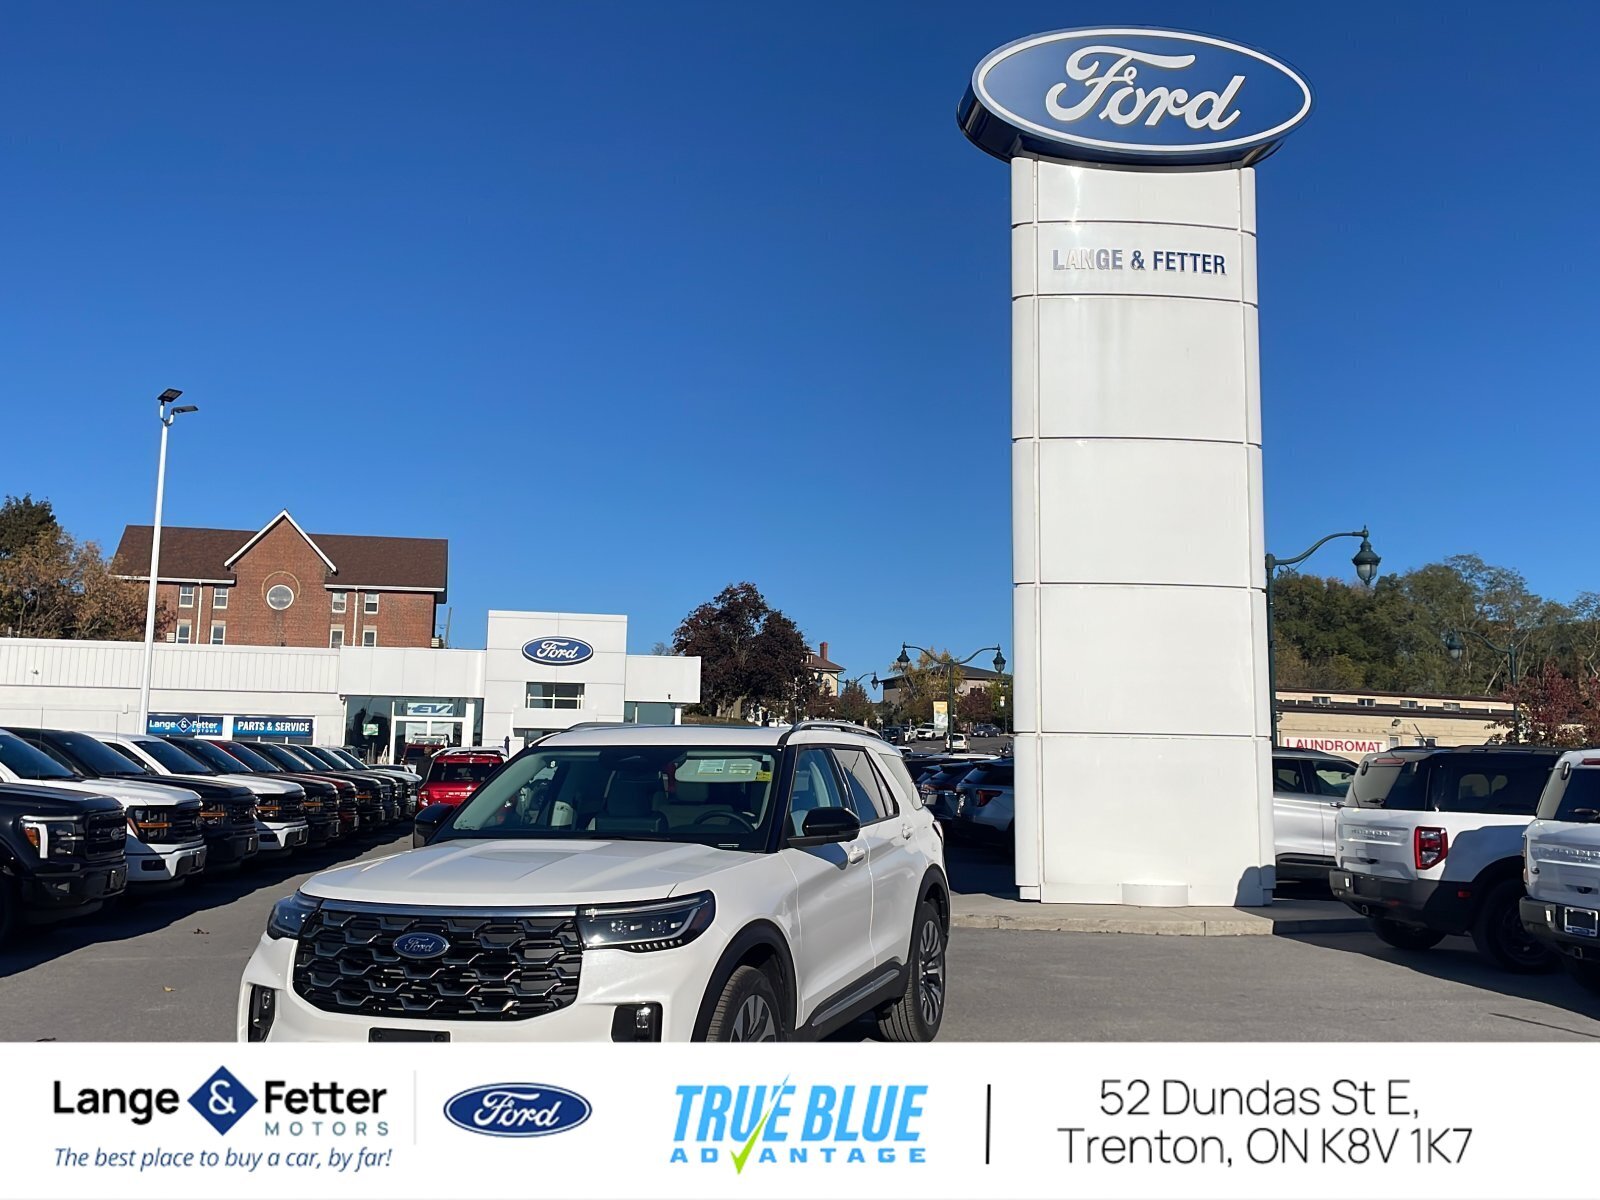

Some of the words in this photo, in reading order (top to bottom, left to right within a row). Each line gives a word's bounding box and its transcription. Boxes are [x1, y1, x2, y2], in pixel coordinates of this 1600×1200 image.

[1045, 45, 1246, 132] Ford
[1052, 249, 1123, 271] LANGE
[1131, 249, 1145, 271] &
[1153, 250, 1227, 275] FETTER
[536, 640, 580, 659] Ford
[149, 719, 176, 730] Lange
[180, 720, 187, 729] &
[192, 720, 218, 729] Fetter
[237, 720, 265, 731] PARTS
[267, 721, 273, 731] &
[275, 721, 310, 732] SERVICE
[1286, 738, 1383, 753] LAUNDROMAT
[404, 937, 436, 952] Ford
